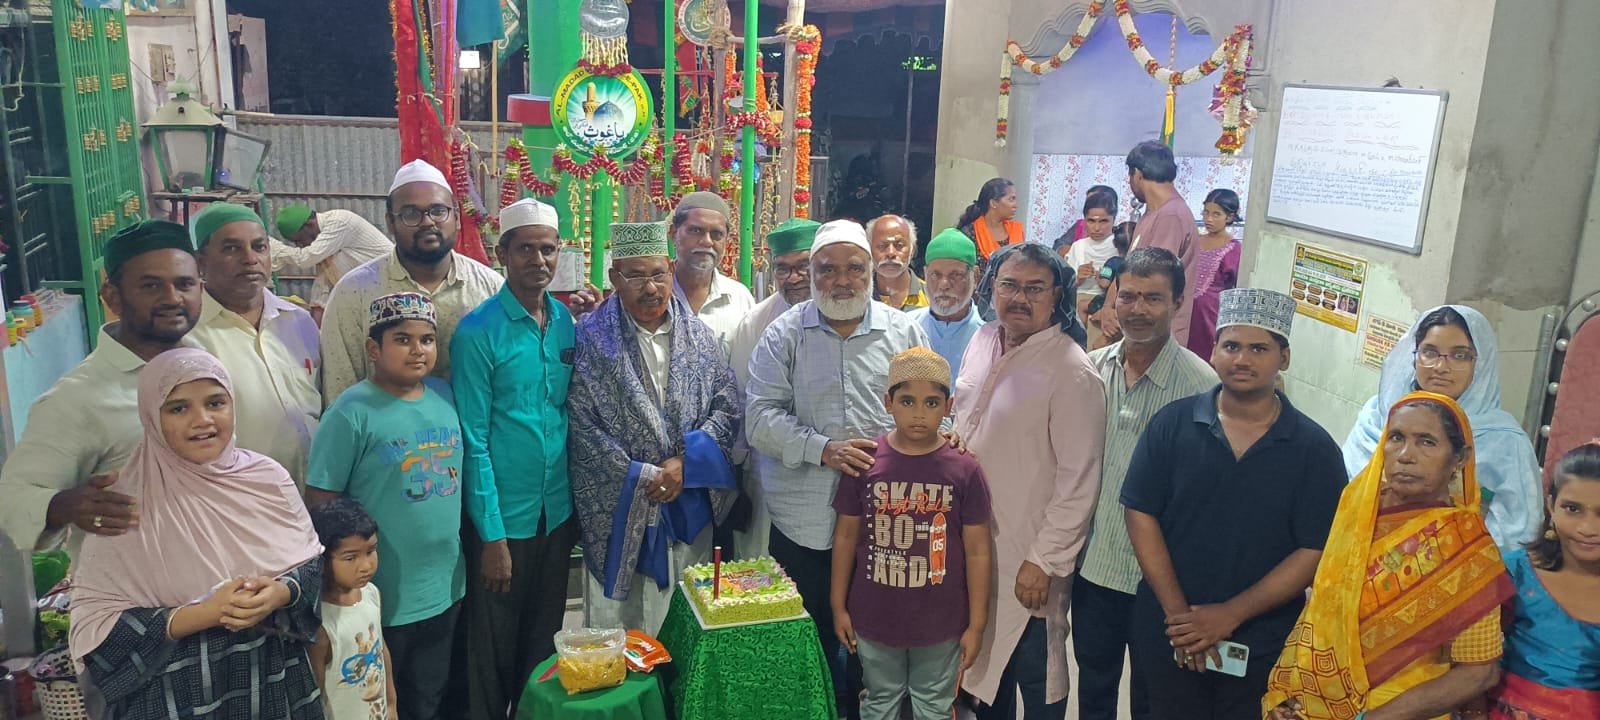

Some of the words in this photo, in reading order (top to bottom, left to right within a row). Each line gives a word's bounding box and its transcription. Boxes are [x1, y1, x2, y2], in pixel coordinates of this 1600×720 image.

[400, 448, 458, 503] 35
[873, 481, 954, 511] SKATE
[932, 539, 944, 551] 05
[873, 551, 928, 588] ARD
